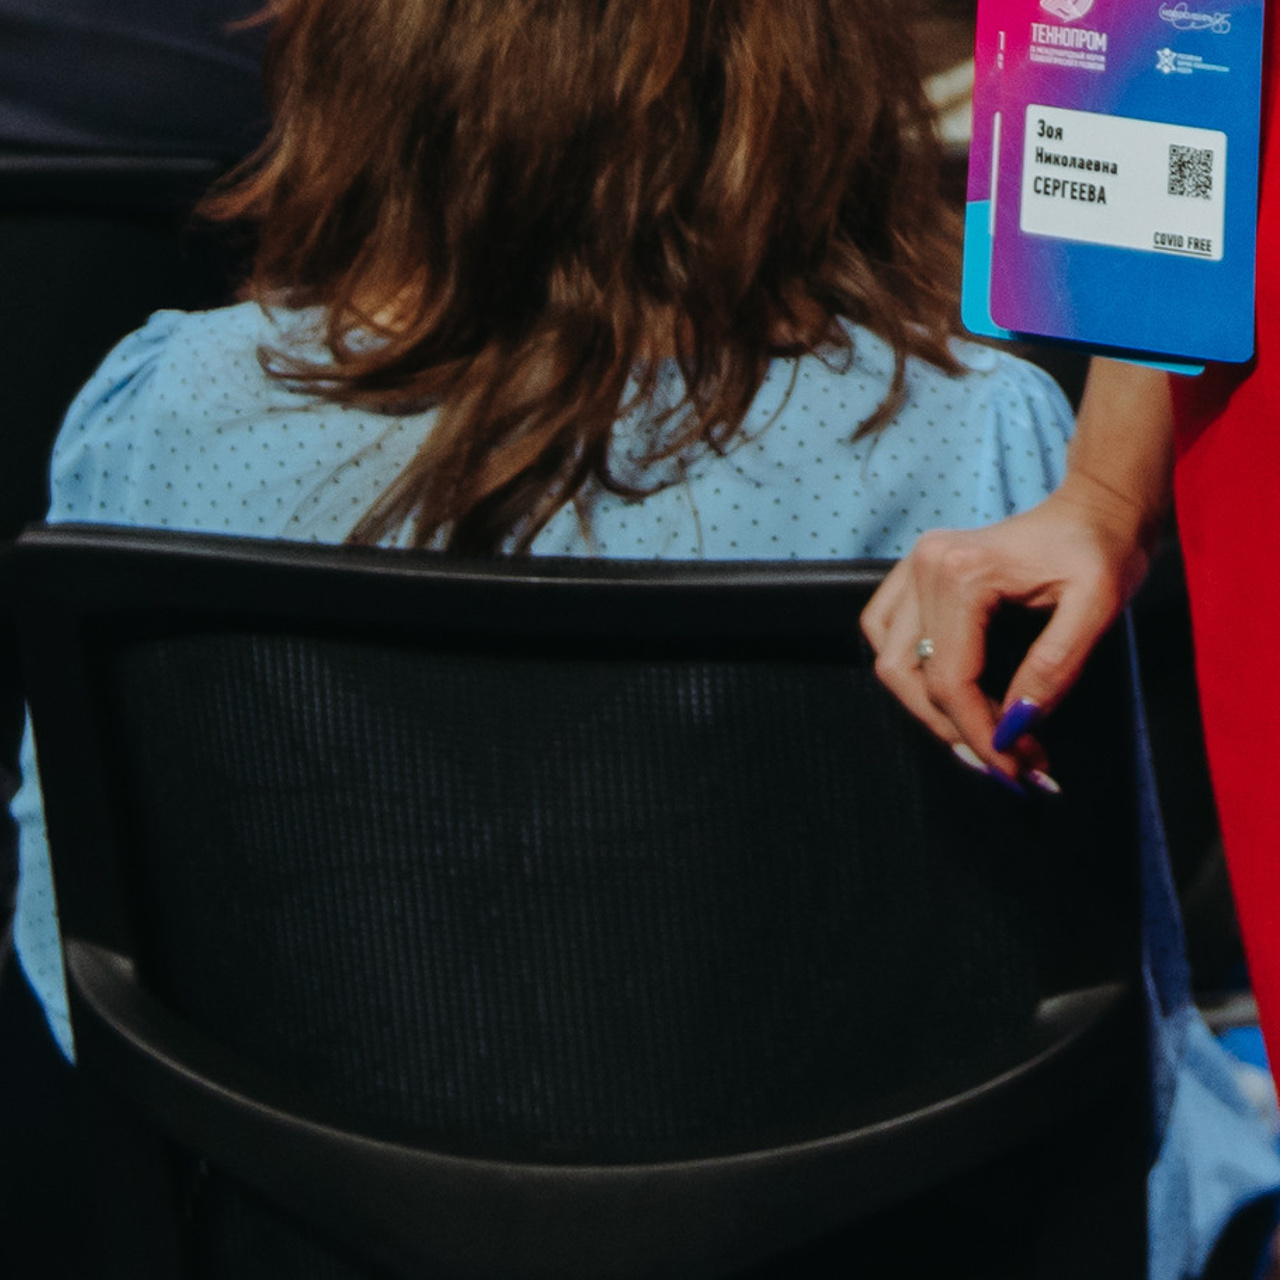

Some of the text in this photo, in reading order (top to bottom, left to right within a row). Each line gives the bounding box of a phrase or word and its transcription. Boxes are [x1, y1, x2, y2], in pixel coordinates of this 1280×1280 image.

[1030, 22, 1108, 53] ТЕХНОПРОМ
[1037, 118, 1063, 141] Зоя
[1034, 146, 1119, 175] Николаевна
[1033, 175, 1107, 205] СЕРГЕЕВА
[1153, 231, 1213, 253] COVID FREE
